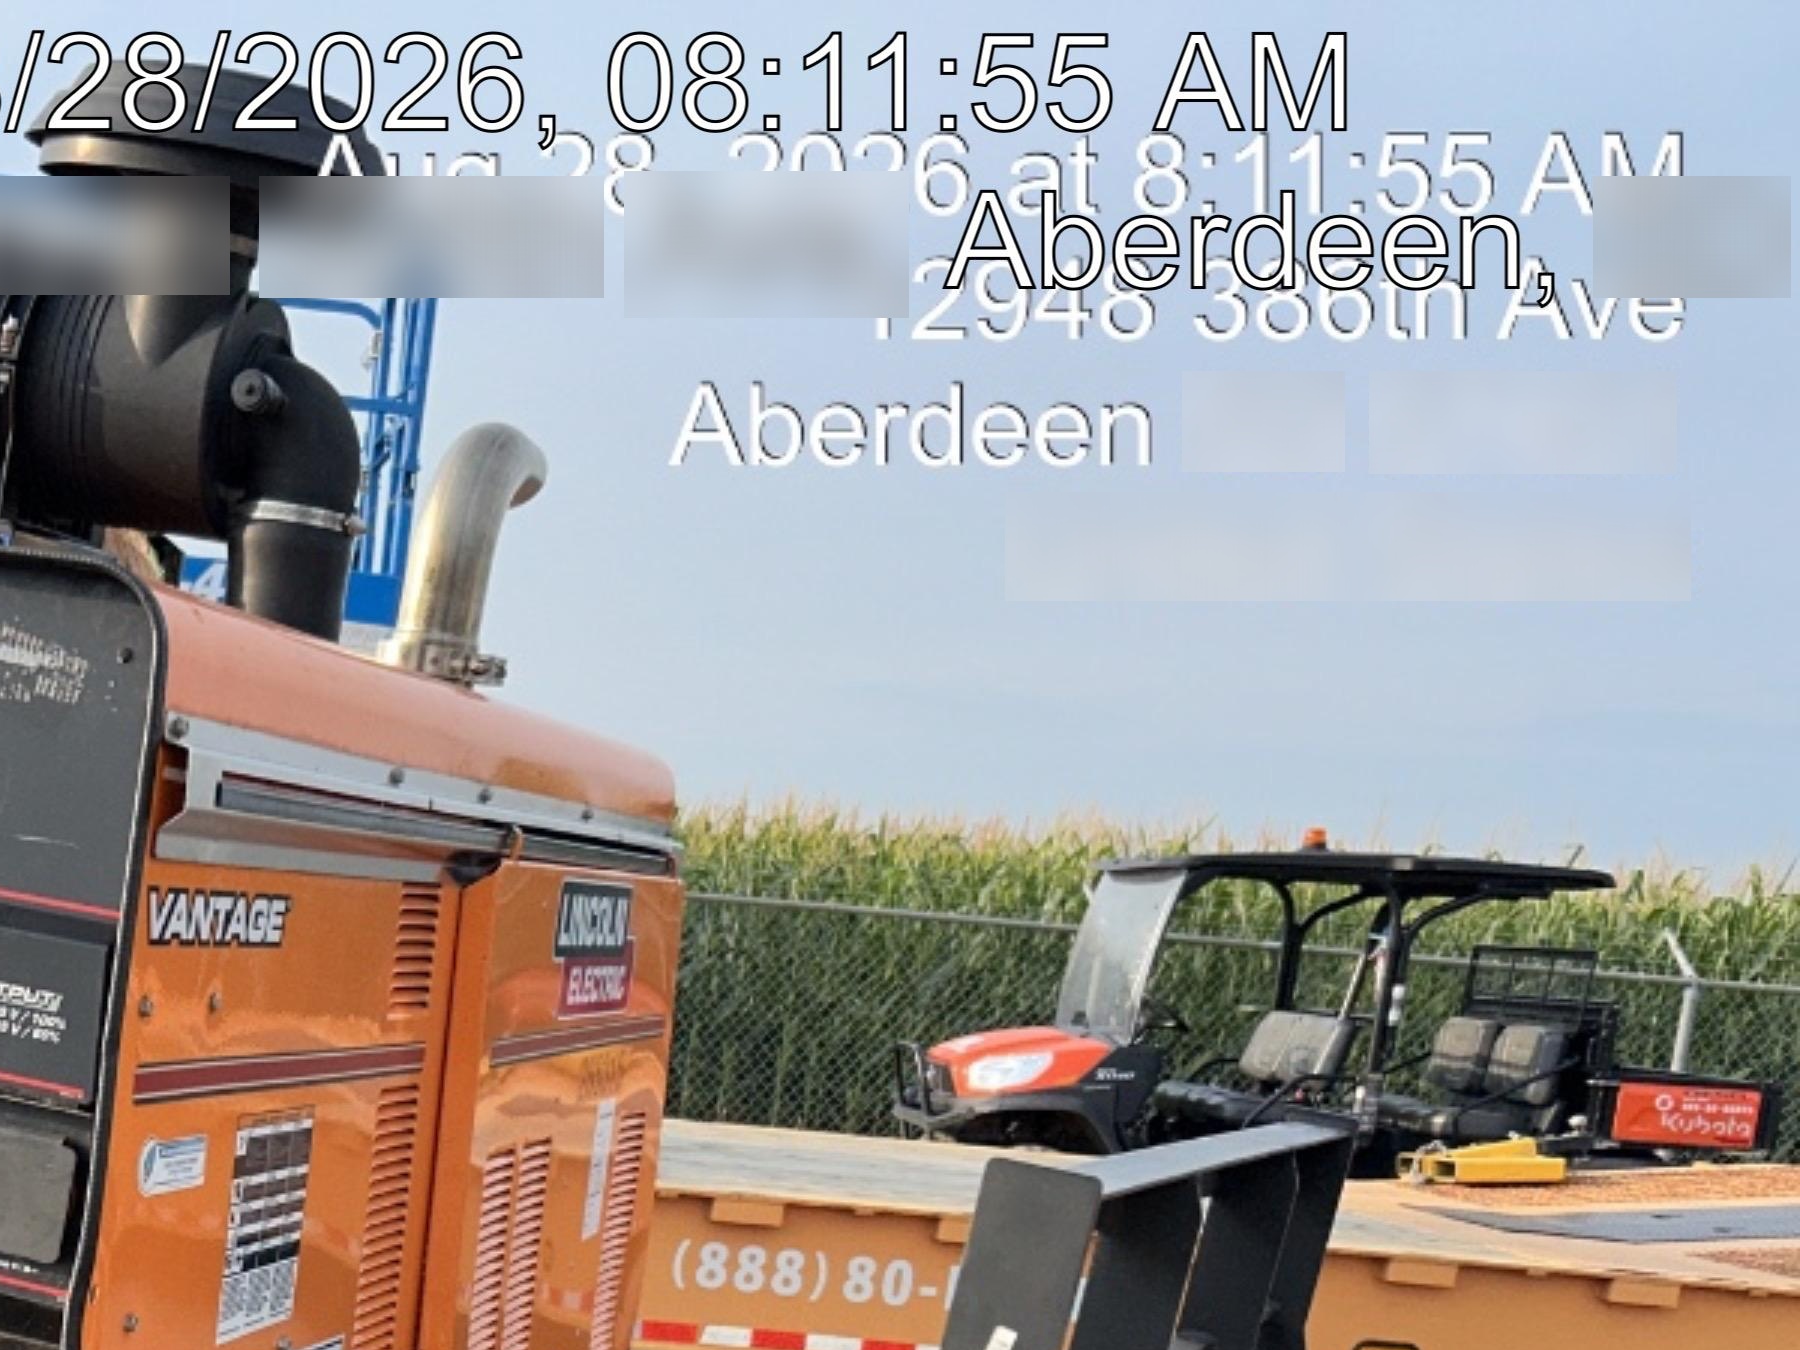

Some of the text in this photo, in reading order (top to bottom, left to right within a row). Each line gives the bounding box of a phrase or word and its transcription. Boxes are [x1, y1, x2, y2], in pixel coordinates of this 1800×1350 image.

[149, 891, 287, 943] VANTAGE
[558, 893, 629, 946] LINCOLN
[566, 964, 627, 1006] ELECTRIC
[1662, 1113, 1750, 1137] Kubota
[672, 1237, 828, 1303] (888)
